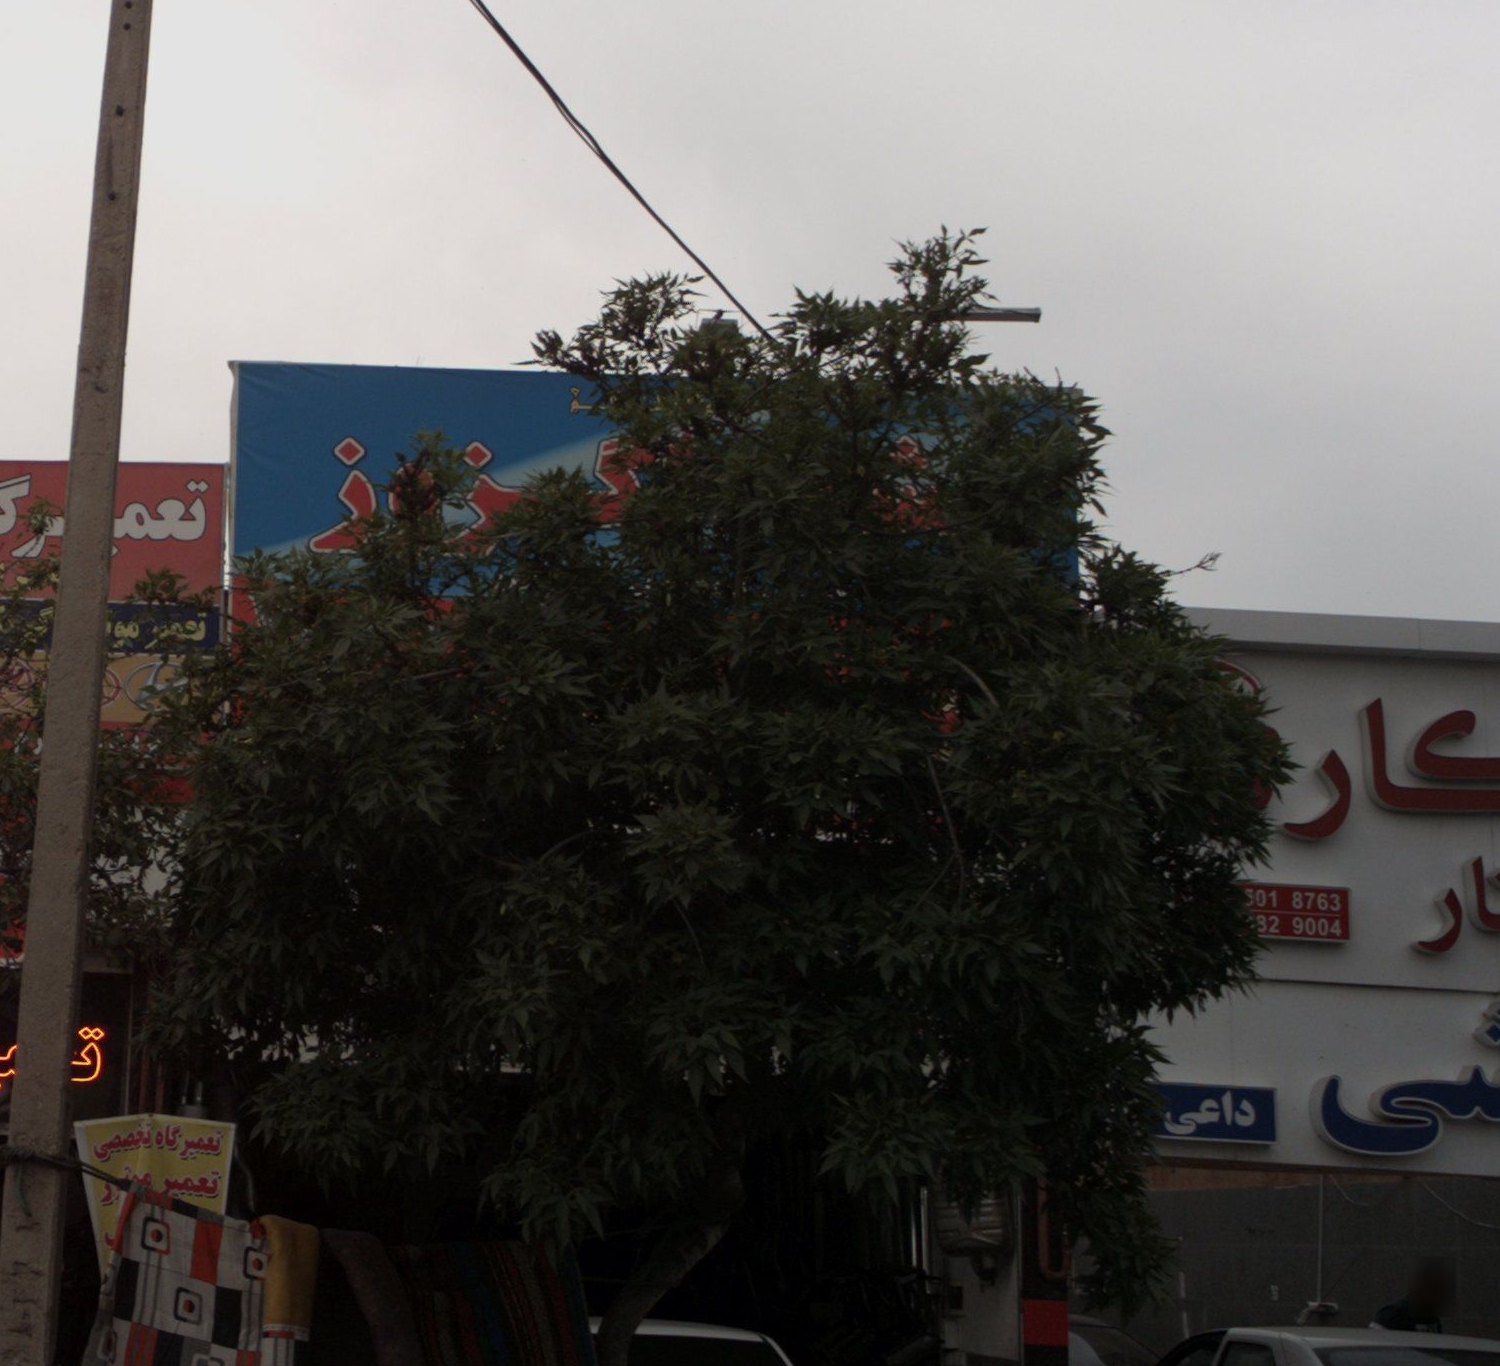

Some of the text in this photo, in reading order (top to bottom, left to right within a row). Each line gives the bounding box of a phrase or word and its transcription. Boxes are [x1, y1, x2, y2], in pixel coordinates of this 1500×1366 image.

[1292, 891, 1341, 912] 8763
[1292, 916, 1342, 937] 9004
[1164, 1089, 1257, 1136] داعی
